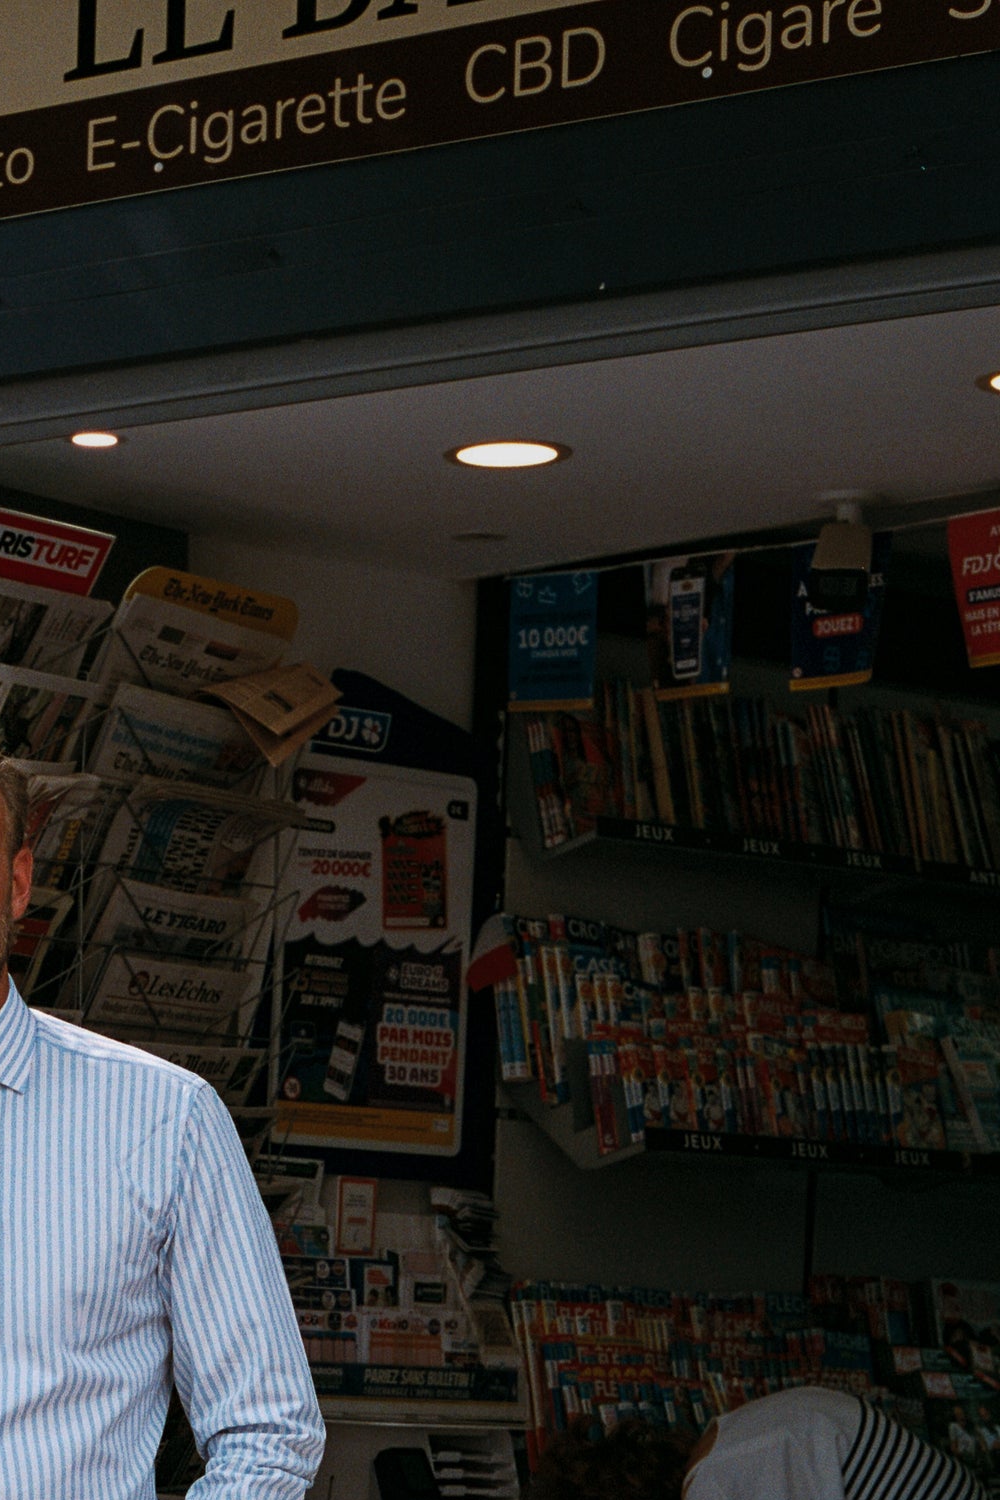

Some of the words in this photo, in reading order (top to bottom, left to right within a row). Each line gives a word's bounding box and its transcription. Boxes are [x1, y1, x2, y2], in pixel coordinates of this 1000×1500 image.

[86, 73, 407, 172] E-Cigarette
[465, 27, 606, 103] CBD
[670, 0, 882, 72] Cigare
[635, 824, 675, 842] JEUX
[743, 837, 782, 855] JEUX
[846, 851, 883, 868] JEUX
[379, 1026, 409, 1043] PAR
[412, 1029, 453, 1048] MOIS
[380, 1045, 451, 1066] PENDANT
[684, 1132, 724, 1151] JEUX
[792, 1140, 830, 1159] JEUX
[894, 1150, 931, 1167] JEUX
